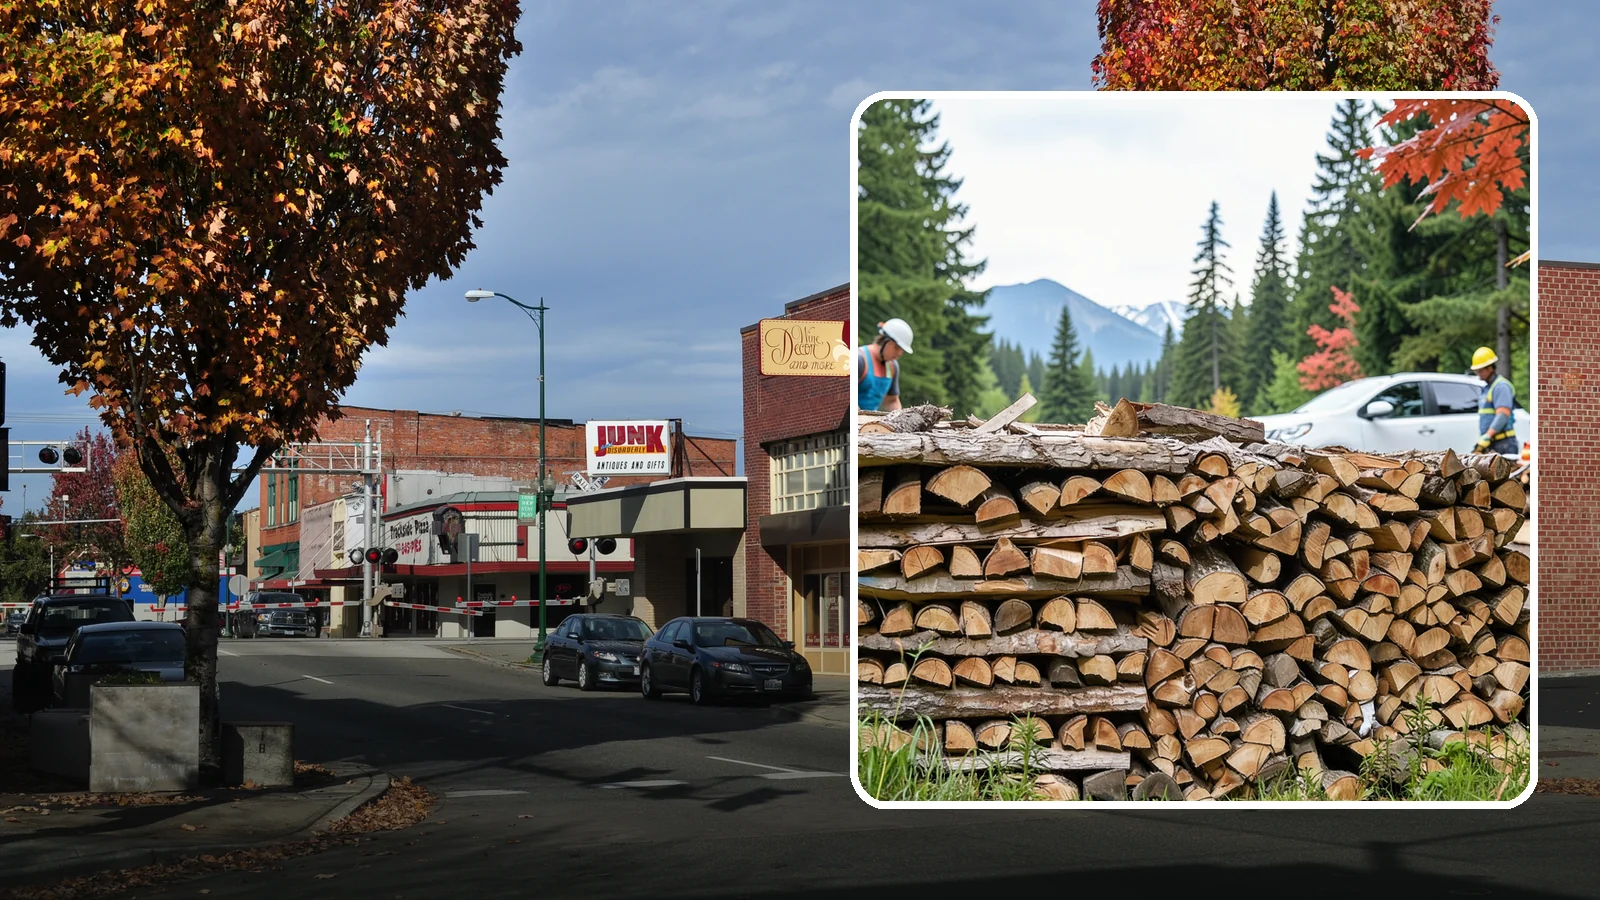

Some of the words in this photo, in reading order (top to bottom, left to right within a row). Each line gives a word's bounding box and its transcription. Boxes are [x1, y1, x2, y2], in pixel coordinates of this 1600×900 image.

[595, 424, 666, 457] JUNK
[607, 446, 645, 454] DISORDERLY
[597, 461, 628, 470] ANTIQUES
[631, 461, 644, 470] AND
[647, 460, 665, 470] GIFTS
[414, 519, 429, 534] Pizza
